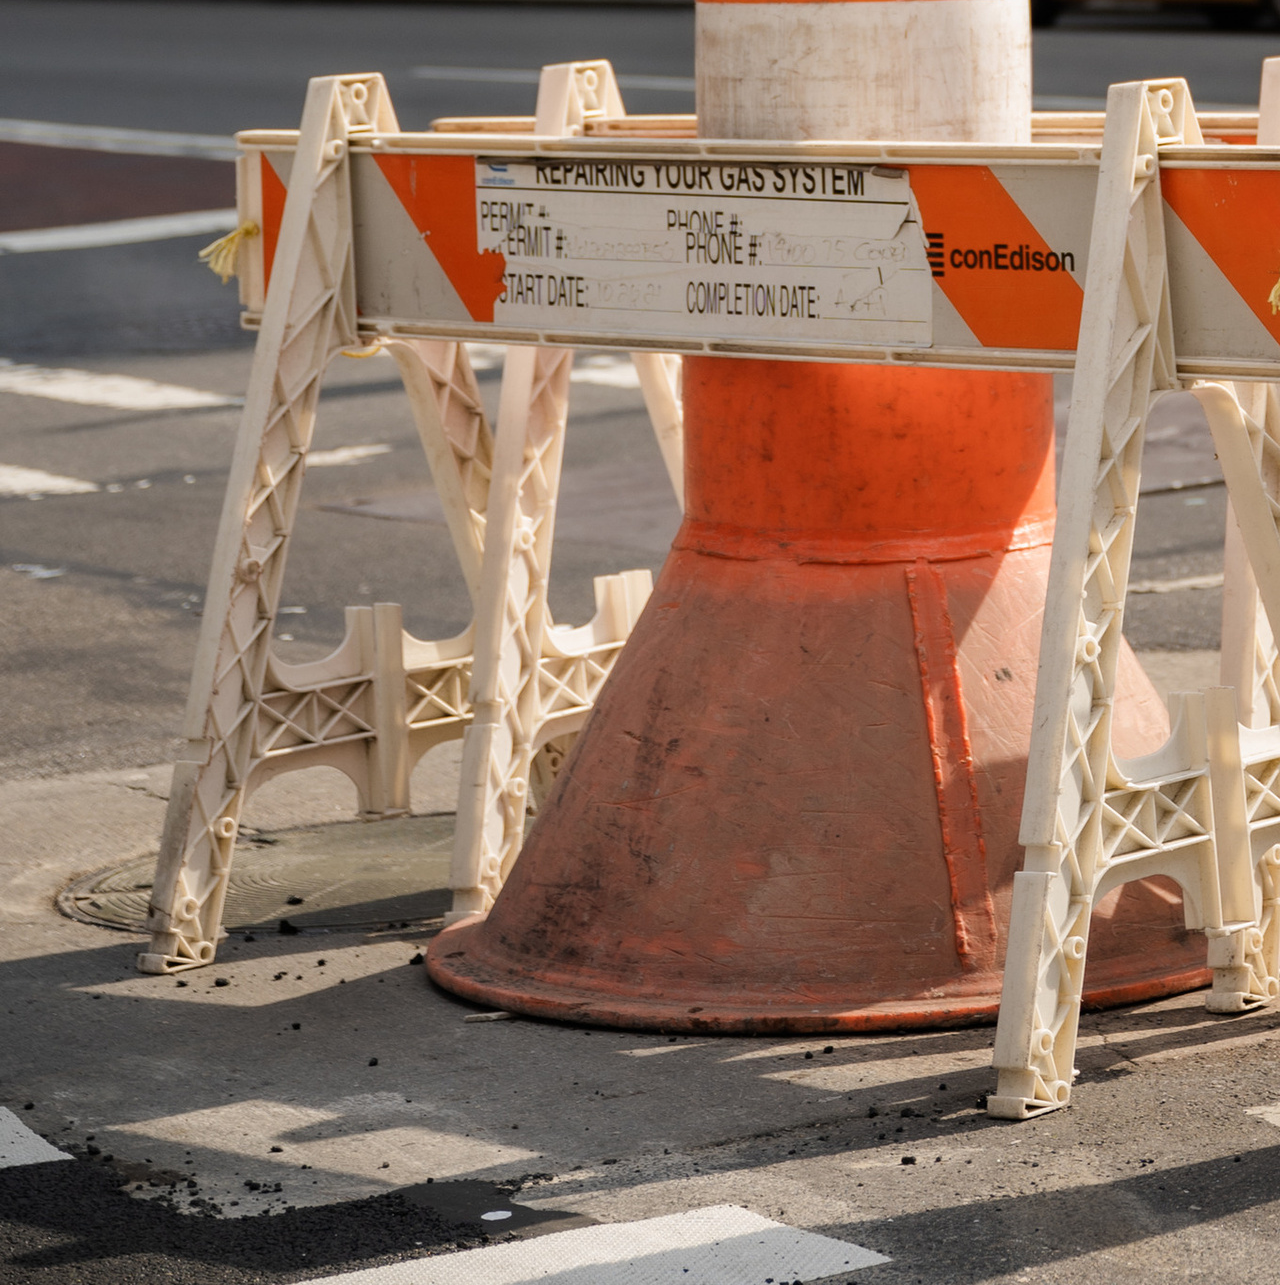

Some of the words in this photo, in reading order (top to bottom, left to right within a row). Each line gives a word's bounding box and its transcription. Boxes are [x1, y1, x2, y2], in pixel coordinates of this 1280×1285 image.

[536, 164, 645, 188] REPAIRING
[653, 165, 713, 190] YOUR
[719, 166, 766, 192] GAS
[772, 167, 865, 196] SYSTEM
[498, 225, 551, 257] ERMIT
[686, 232, 743, 265] PHONE
[949, 243, 1075, 272] conEdison
[548, 275, 589, 308] DATE:
[686, 281, 775, 317] COMPLETION
[780, 285, 820, 319] DATE:
